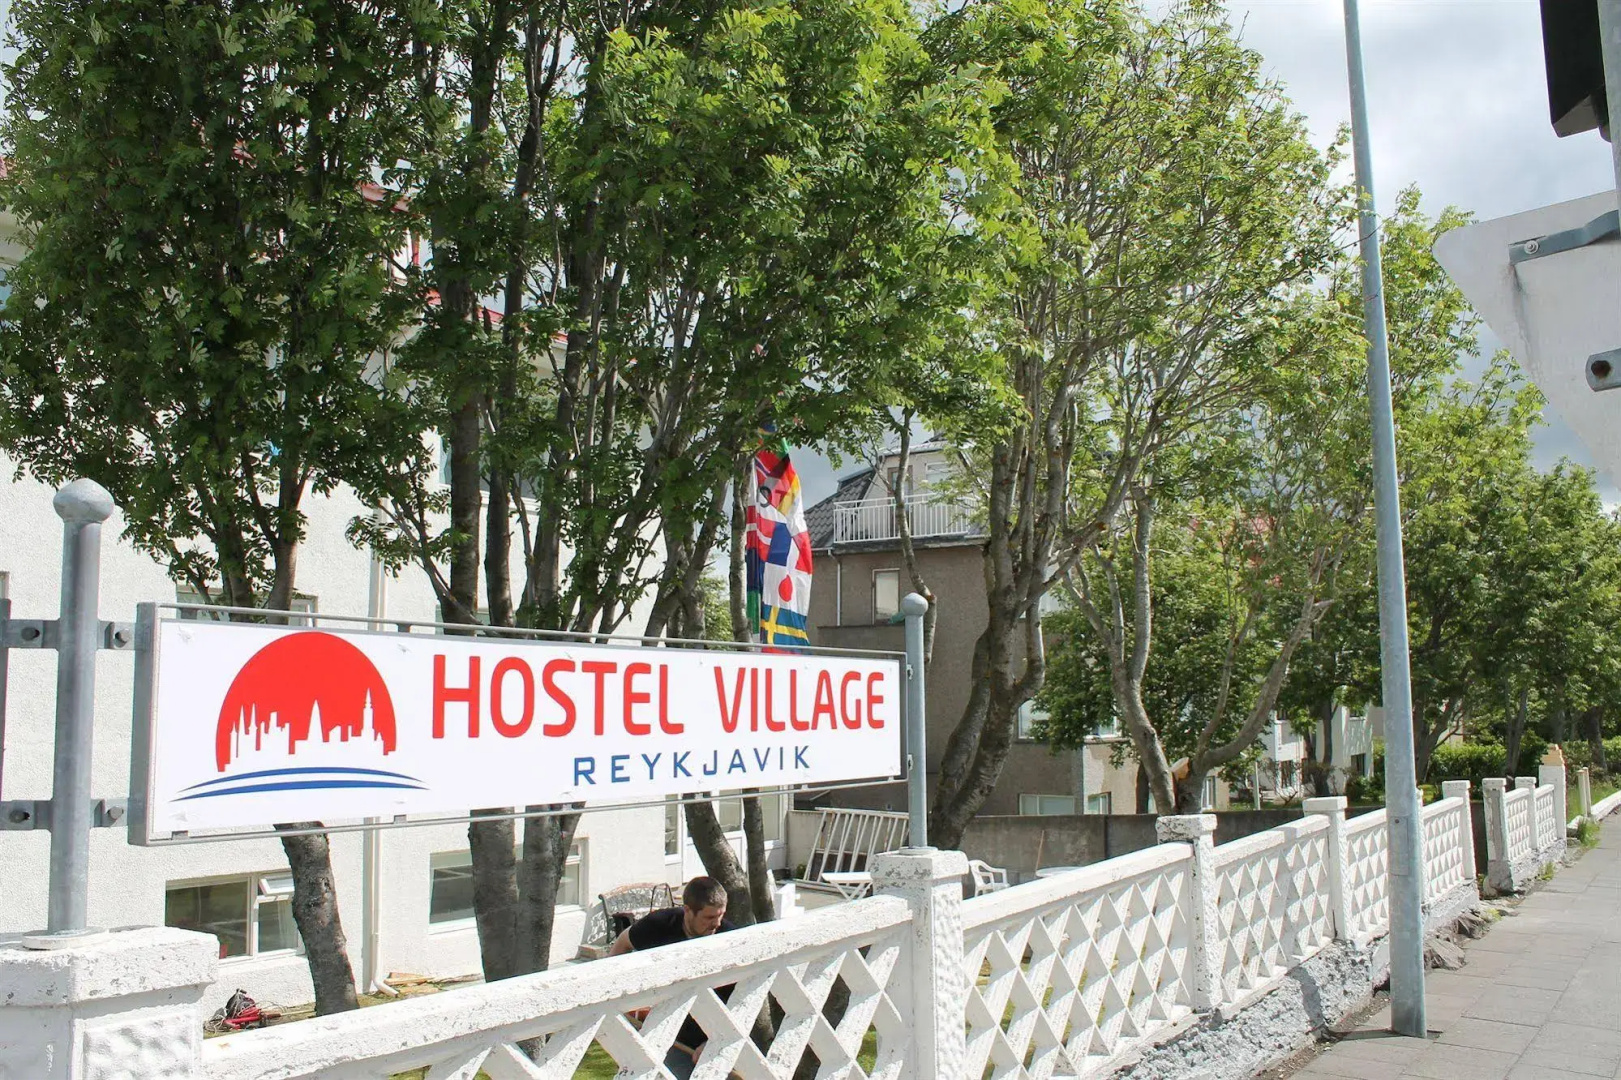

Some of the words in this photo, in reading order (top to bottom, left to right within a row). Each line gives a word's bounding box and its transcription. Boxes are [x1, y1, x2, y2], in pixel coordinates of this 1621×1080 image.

[432, 654, 684, 739] HOSTEL
[714, 666, 885, 734] VILLAGE
[574, 745, 811, 786] REYKJAVIK
